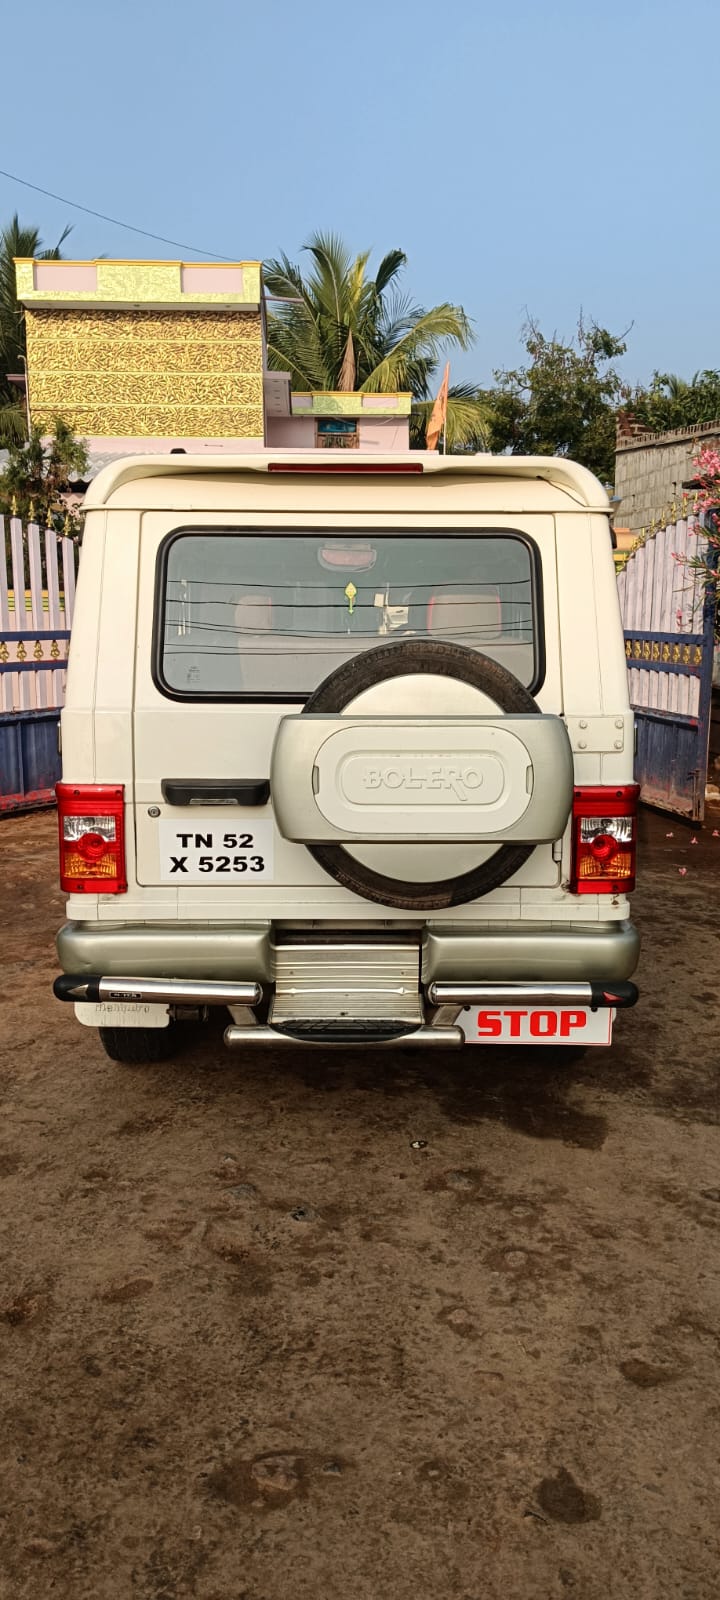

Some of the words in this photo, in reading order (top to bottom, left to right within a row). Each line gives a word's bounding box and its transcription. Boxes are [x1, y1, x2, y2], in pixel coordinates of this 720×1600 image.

[363, 767, 484, 801] BOLERO
[176, 833, 213, 848] TN
[223, 833, 254, 848] 52
[169, 856, 189, 872] X
[198, 855, 265, 872] 5253
[477, 1010, 587, 1037] STOP
